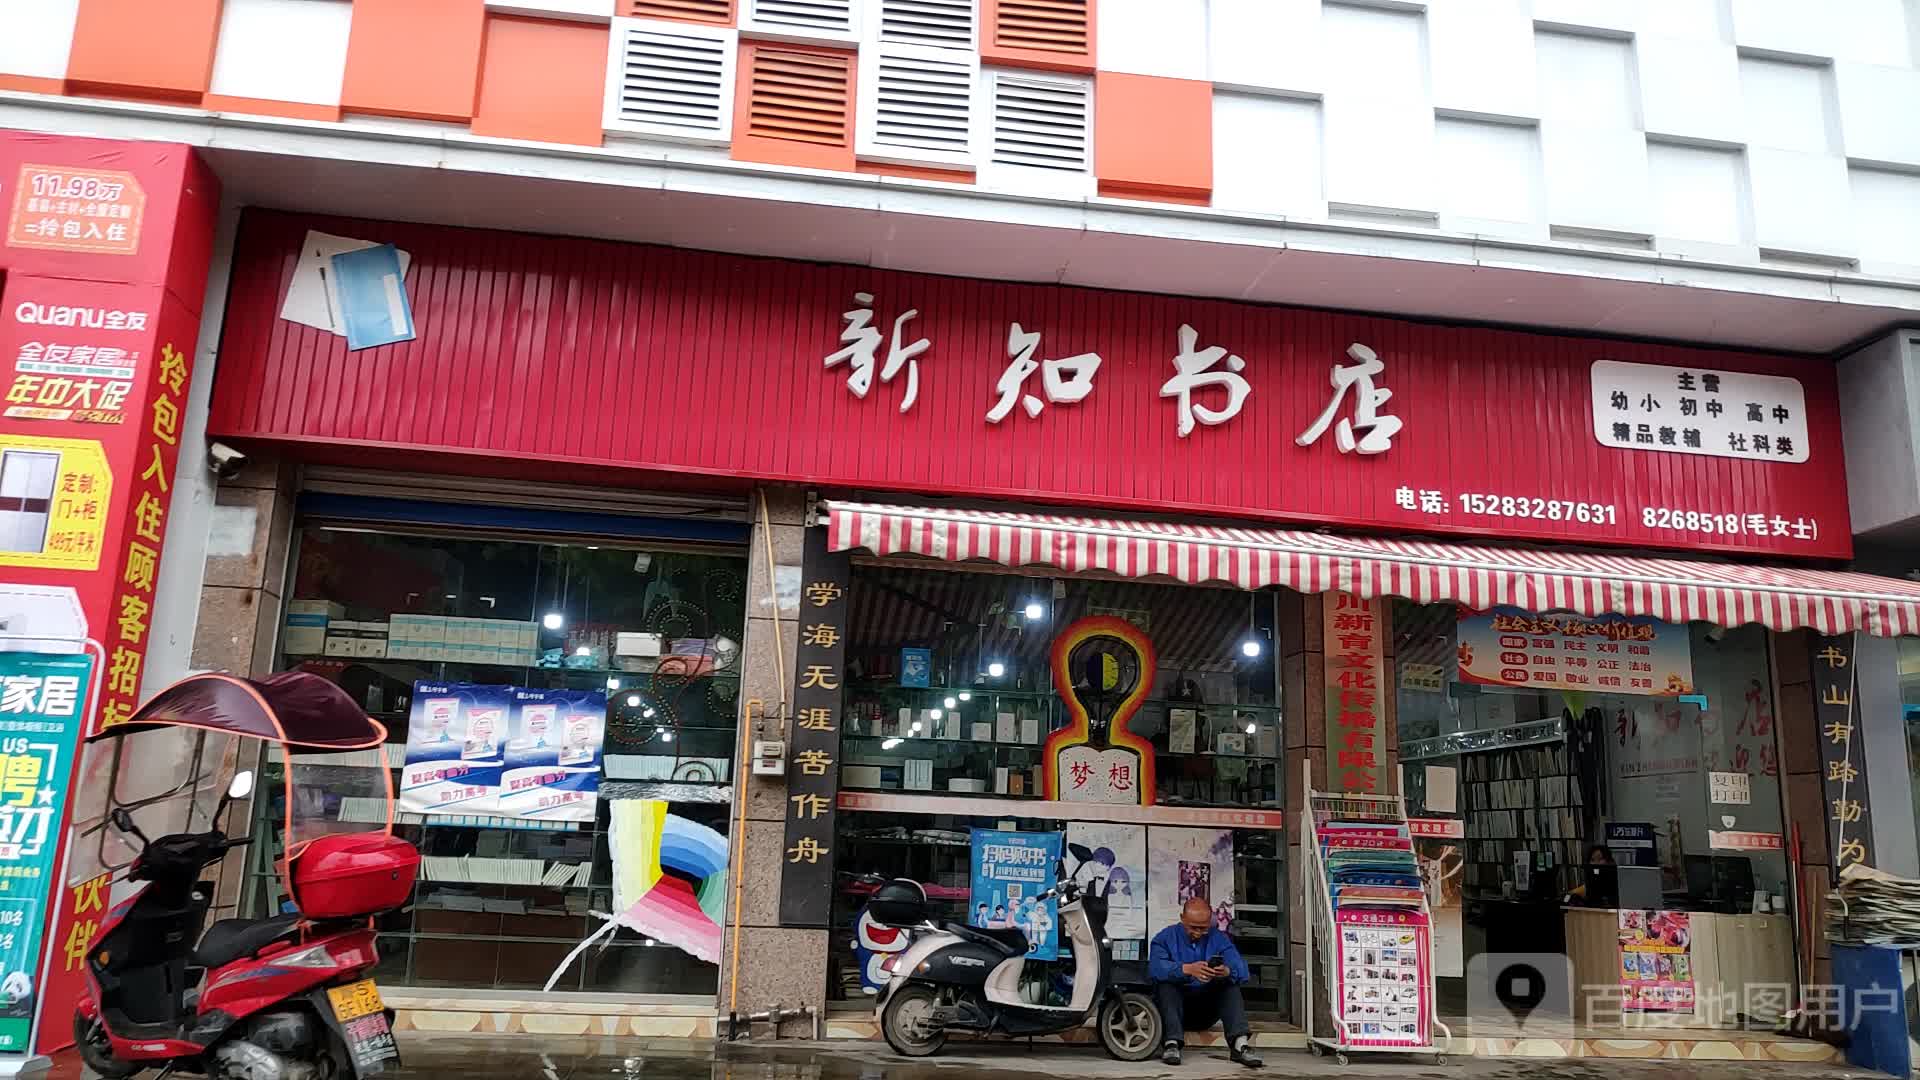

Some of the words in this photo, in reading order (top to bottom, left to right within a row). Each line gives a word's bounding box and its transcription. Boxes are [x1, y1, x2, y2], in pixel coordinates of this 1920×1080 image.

[32, 174, 124, 201] 11.98万
[17, 341, 128, 367] 全友家居
[824, 292, 1402, 455] 新知书店
[1677, 371, 1721, 393] 主营
[5, 374, 133, 411] 年中大促
[1611, 390, 1661, 412] 幼小
[1679, 397, 1724, 418] 初中
[1746, 402, 1789, 424] 高中
[1612, 422, 1702, 449] 精品教辅
[1728, 431, 1794, 455] 社科类
[1459, 492, 1616, 526] 15283287631
[1643, 507, 1818, 541] 8268518(毛女士)
[1489, 613, 1657, 641] 社会主义核心价值观
[1532, 638, 1555, 649] 富强
[1563, 640, 1587, 651] 民主
[1596, 643, 1619, 654] 文明
[1627, 644, 1650, 655] 和谐
[1503, 654, 1526, 664] 社会
[1533, 655, 1555, 665] 自由
[1565, 656, 1588, 667] 平等
[1597, 659, 1620, 670] 公正
[1629, 661, 1652, 672] 法治
[1533, 671, 1557, 681] 爱国
[1566, 673, 1589, 684] 敬业
[1599, 676, 1621, 686] 诚信
[1631, 678, 1653, 689] 友善
[0, 675, 79, 716] 家居
[786, 582, 842, 864] 学海无涯苦作舟
[3, 737, 30, 753] US
[1817, 646, 1866, 864] 书山有路勤为
[1069, 760, 1134, 791] 梦想
[982, 843, 1047, 866] 扫码购书
[64, 873, 107, 971] 伙伴
[1361, 913, 1395, 924] 交通工具
